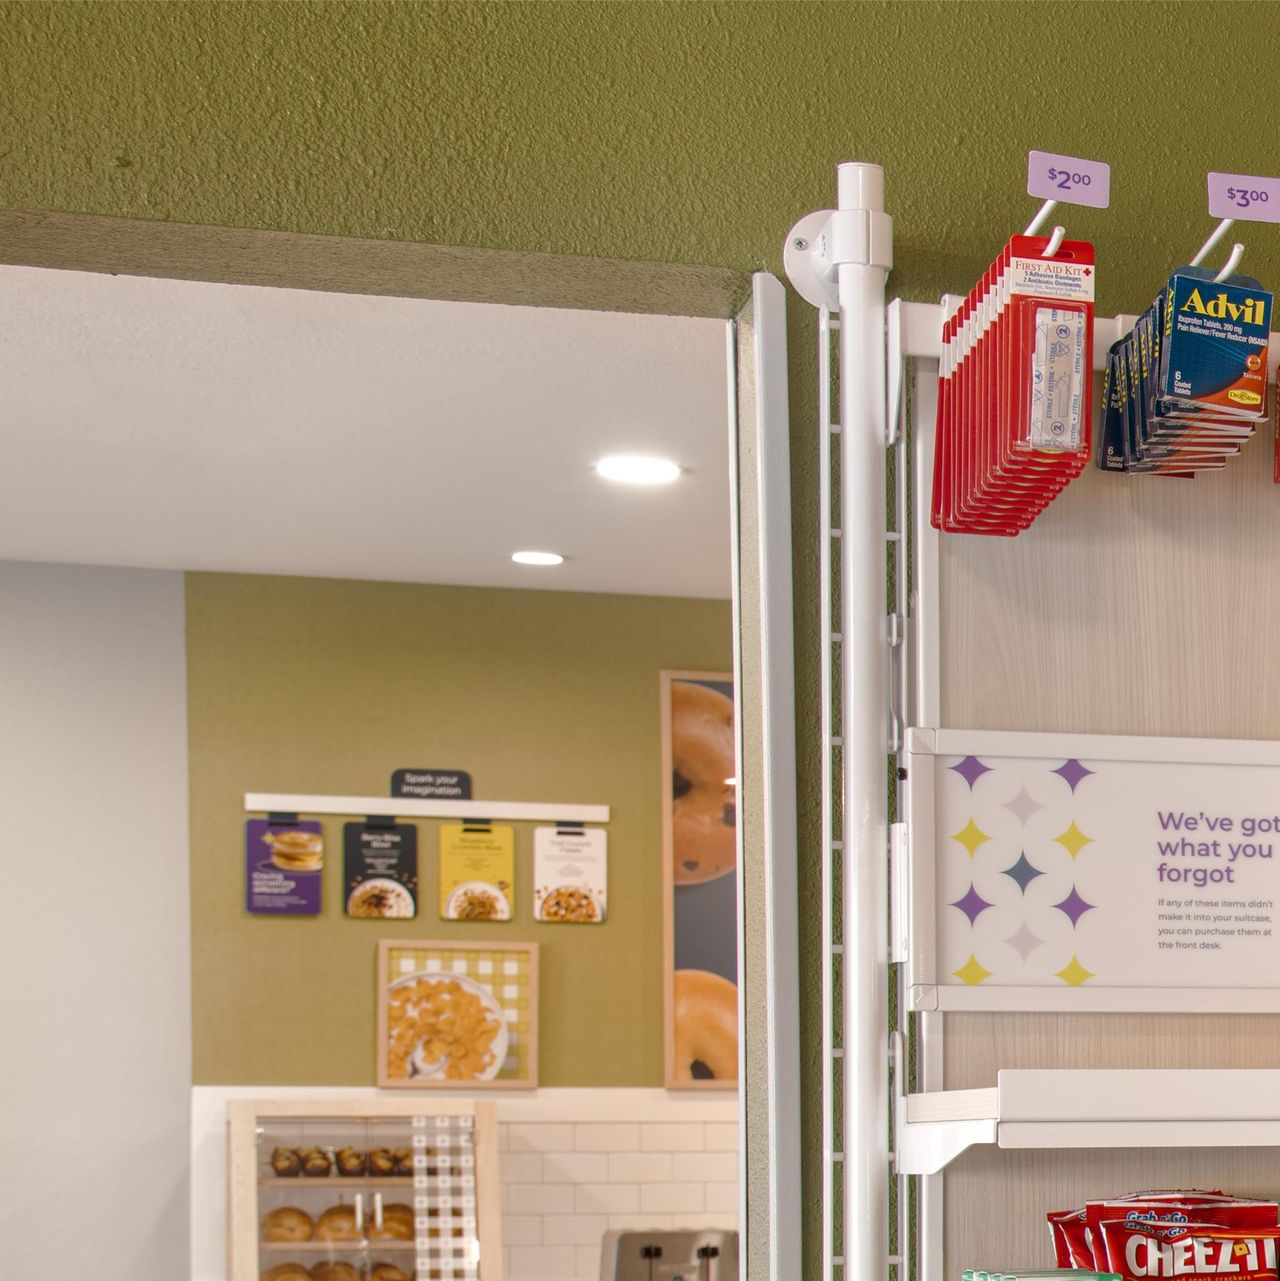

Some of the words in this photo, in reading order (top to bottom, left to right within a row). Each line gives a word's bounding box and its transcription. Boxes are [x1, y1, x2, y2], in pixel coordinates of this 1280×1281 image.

[1014, 260, 1043, 272] FIRST
[1045, 262, 1063, 274] AID
[1065, 264, 1083, 276] KIT
[1181, 287, 1265, 326] Advil
[1157, 810, 1233, 832] We've
[1157, 838, 1221, 858] what
[1228, 842, 1273, 862] you
[1157, 862, 1235, 887] forgot
[1158, 899, 1165, 908] If
[1166, 899, 1182, 910] any
[1184, 899, 1193, 908] of
[1195, 899, 1220, 908] these
[1221, 899, 1245, 908] items
[1248, 899, 1273, 909] didn't
[1158, 913, 1182, 922] make
[1185, 913, 1191, 922] it
[1194, 913, 1210, 922] into
[1212, 915, 1232, 925] your
[1234, 913, 1272, 924] suitcase,
[1158, 928, 1174, 938] you
[1176, 929, 1193, 937] can
[1195, 927, 1235, 939] purchase
[1237, 927, 1261, 937] them
[1263, 928, 1272, 937] at
[1158, 941, 1173, 950] the
[1175, 941, 1197, 950] front
[1199, 941, 1222, 951] desk.
